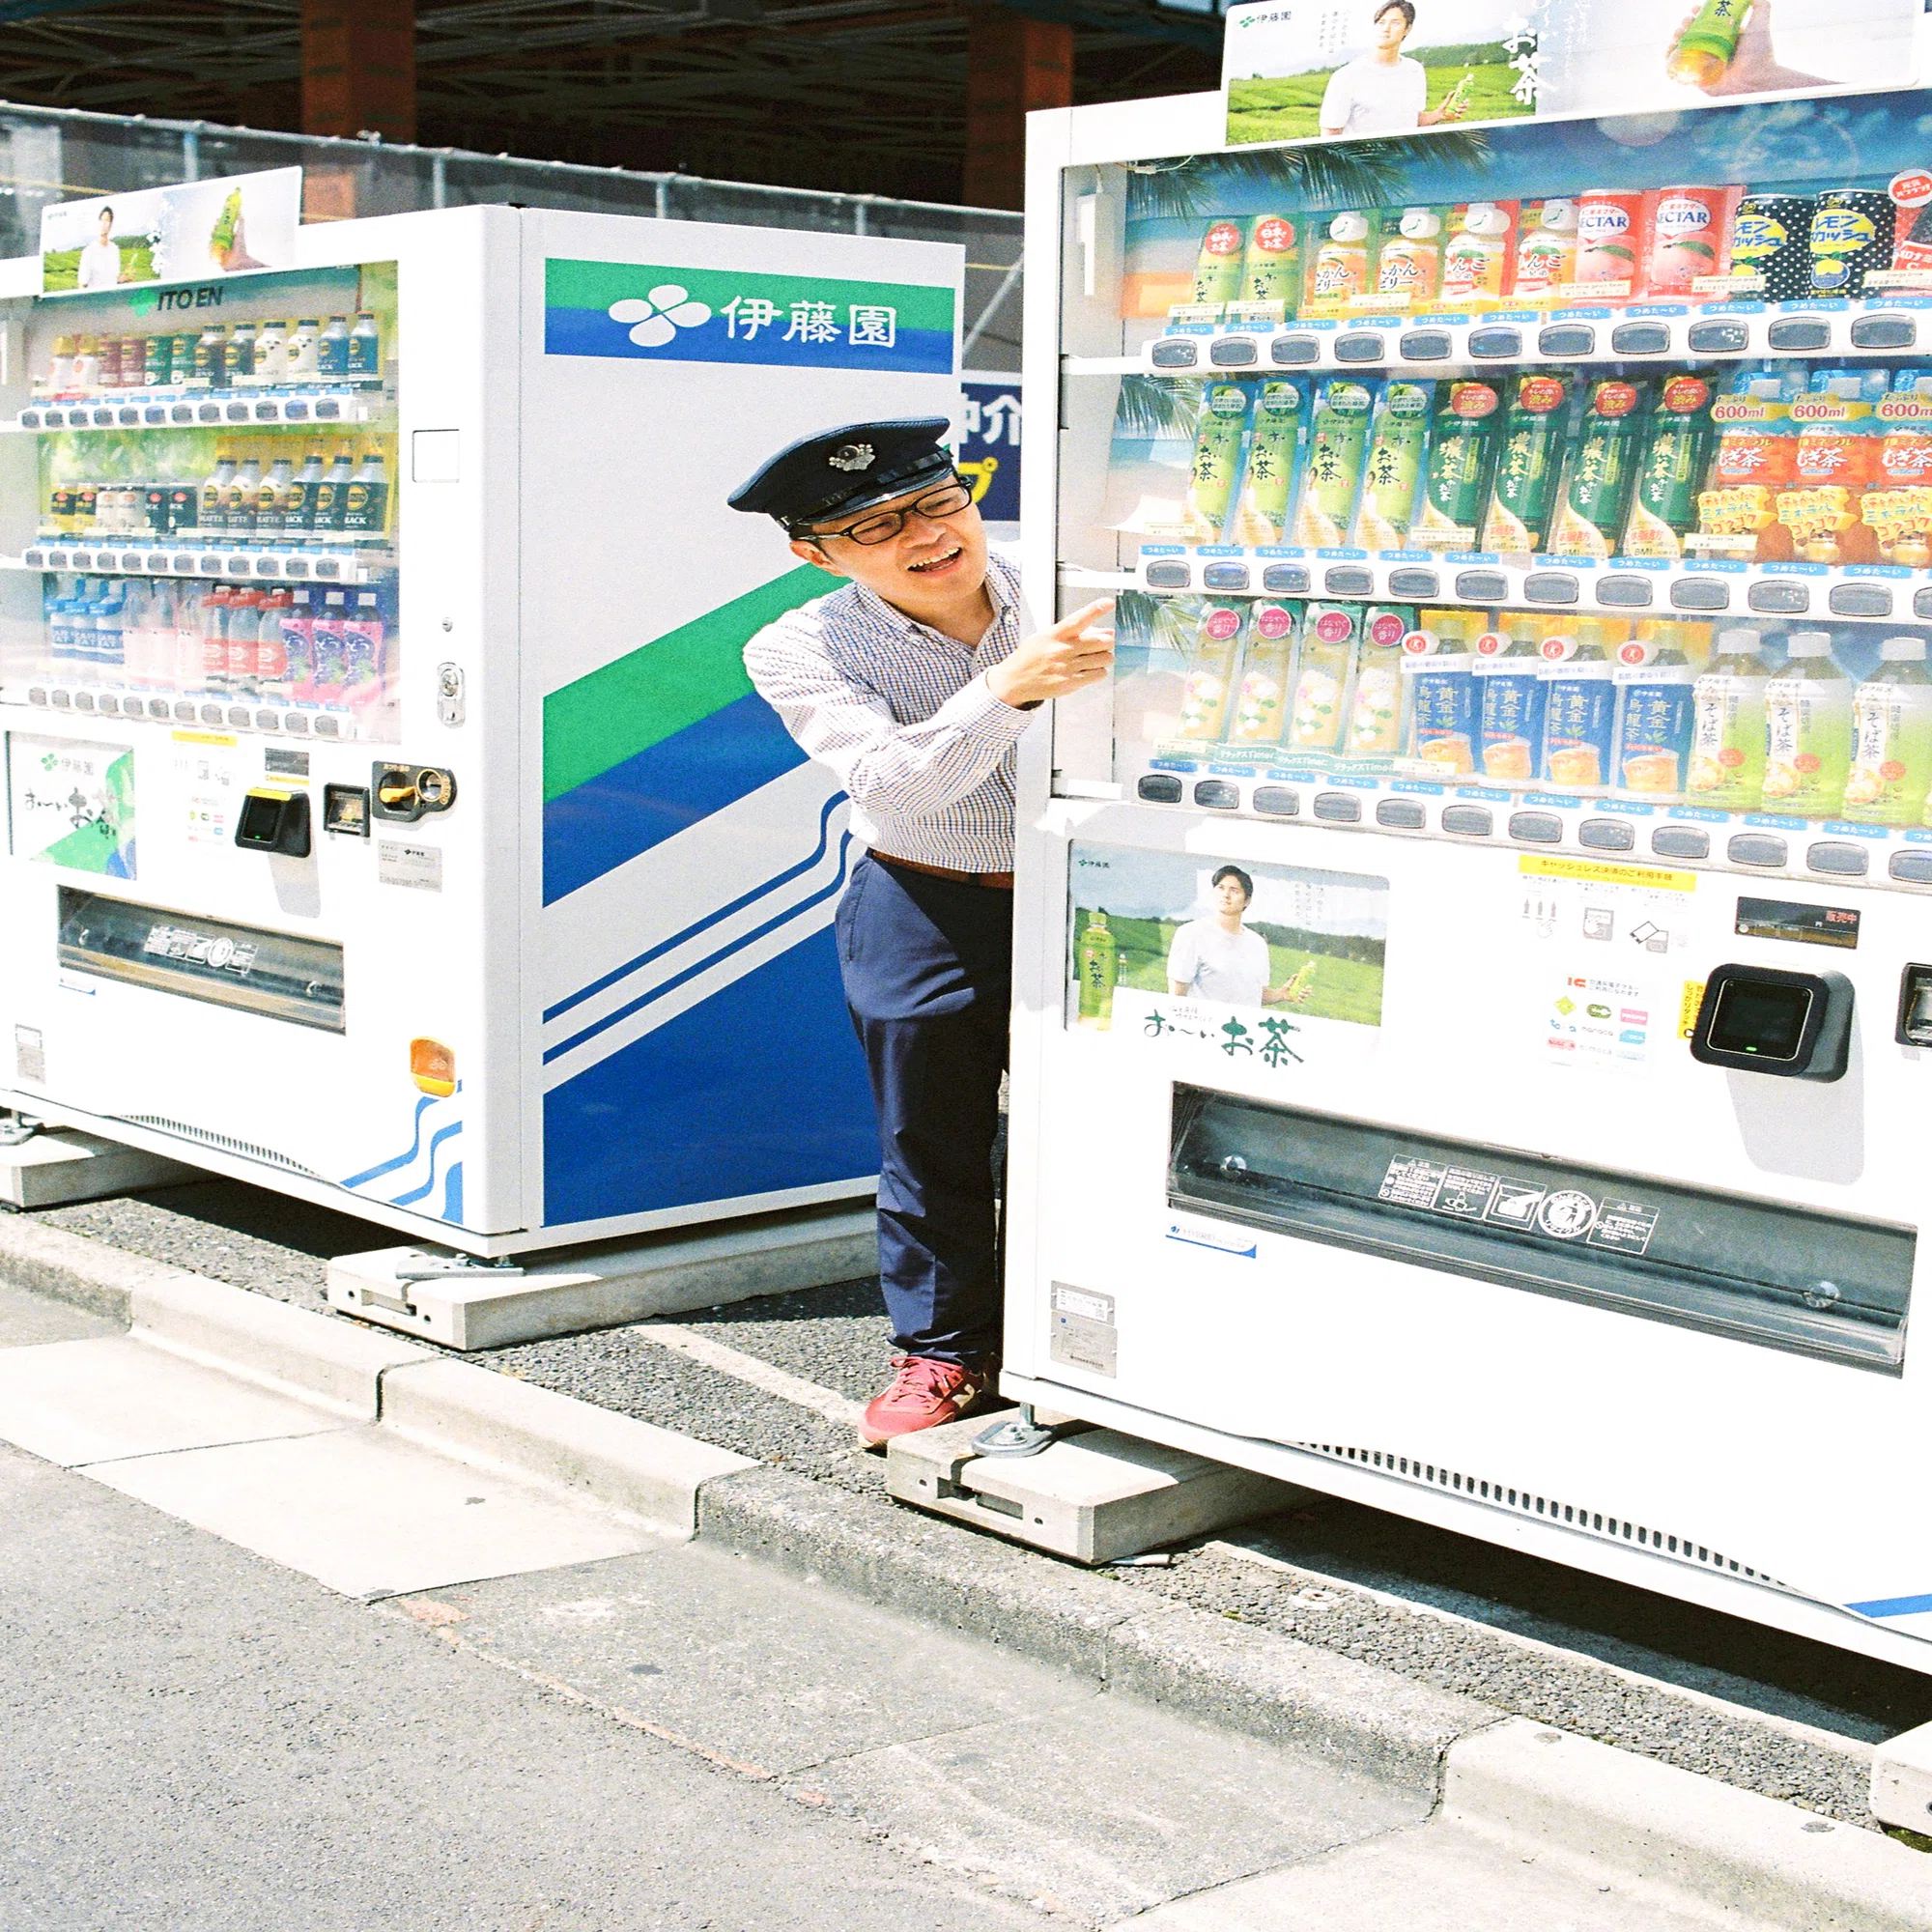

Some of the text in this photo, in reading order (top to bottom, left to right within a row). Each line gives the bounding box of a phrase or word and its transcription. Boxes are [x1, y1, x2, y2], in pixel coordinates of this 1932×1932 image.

[1257, 11, 1292, 23] 伊藤園
[1579, 216, 1628, 229] ECTAR
[1657, 212, 1708, 224] ECTAR
[1816, 214, 1860, 229] レモン
[157, 287, 223, 311] ITO EN
[720, 296, 896, 349] 伊藤園
[1715, 405, 1765, 419] 600ml
[1794, 404, 1845, 419] 600ml
[1436, 687, 1459, 714] 黄金
[1500, 689, 1523, 718] 黄金
[1566, 695, 1589, 724] 黄金
[1646, 699, 1672, 729] 黄金
[1541, 860, 1673, 882] キャッシュレス決済のご利用手順
[1826, 910, 1858, 924] 販売中
[1144, 1009, 1305, 1068] お〜いお茶
